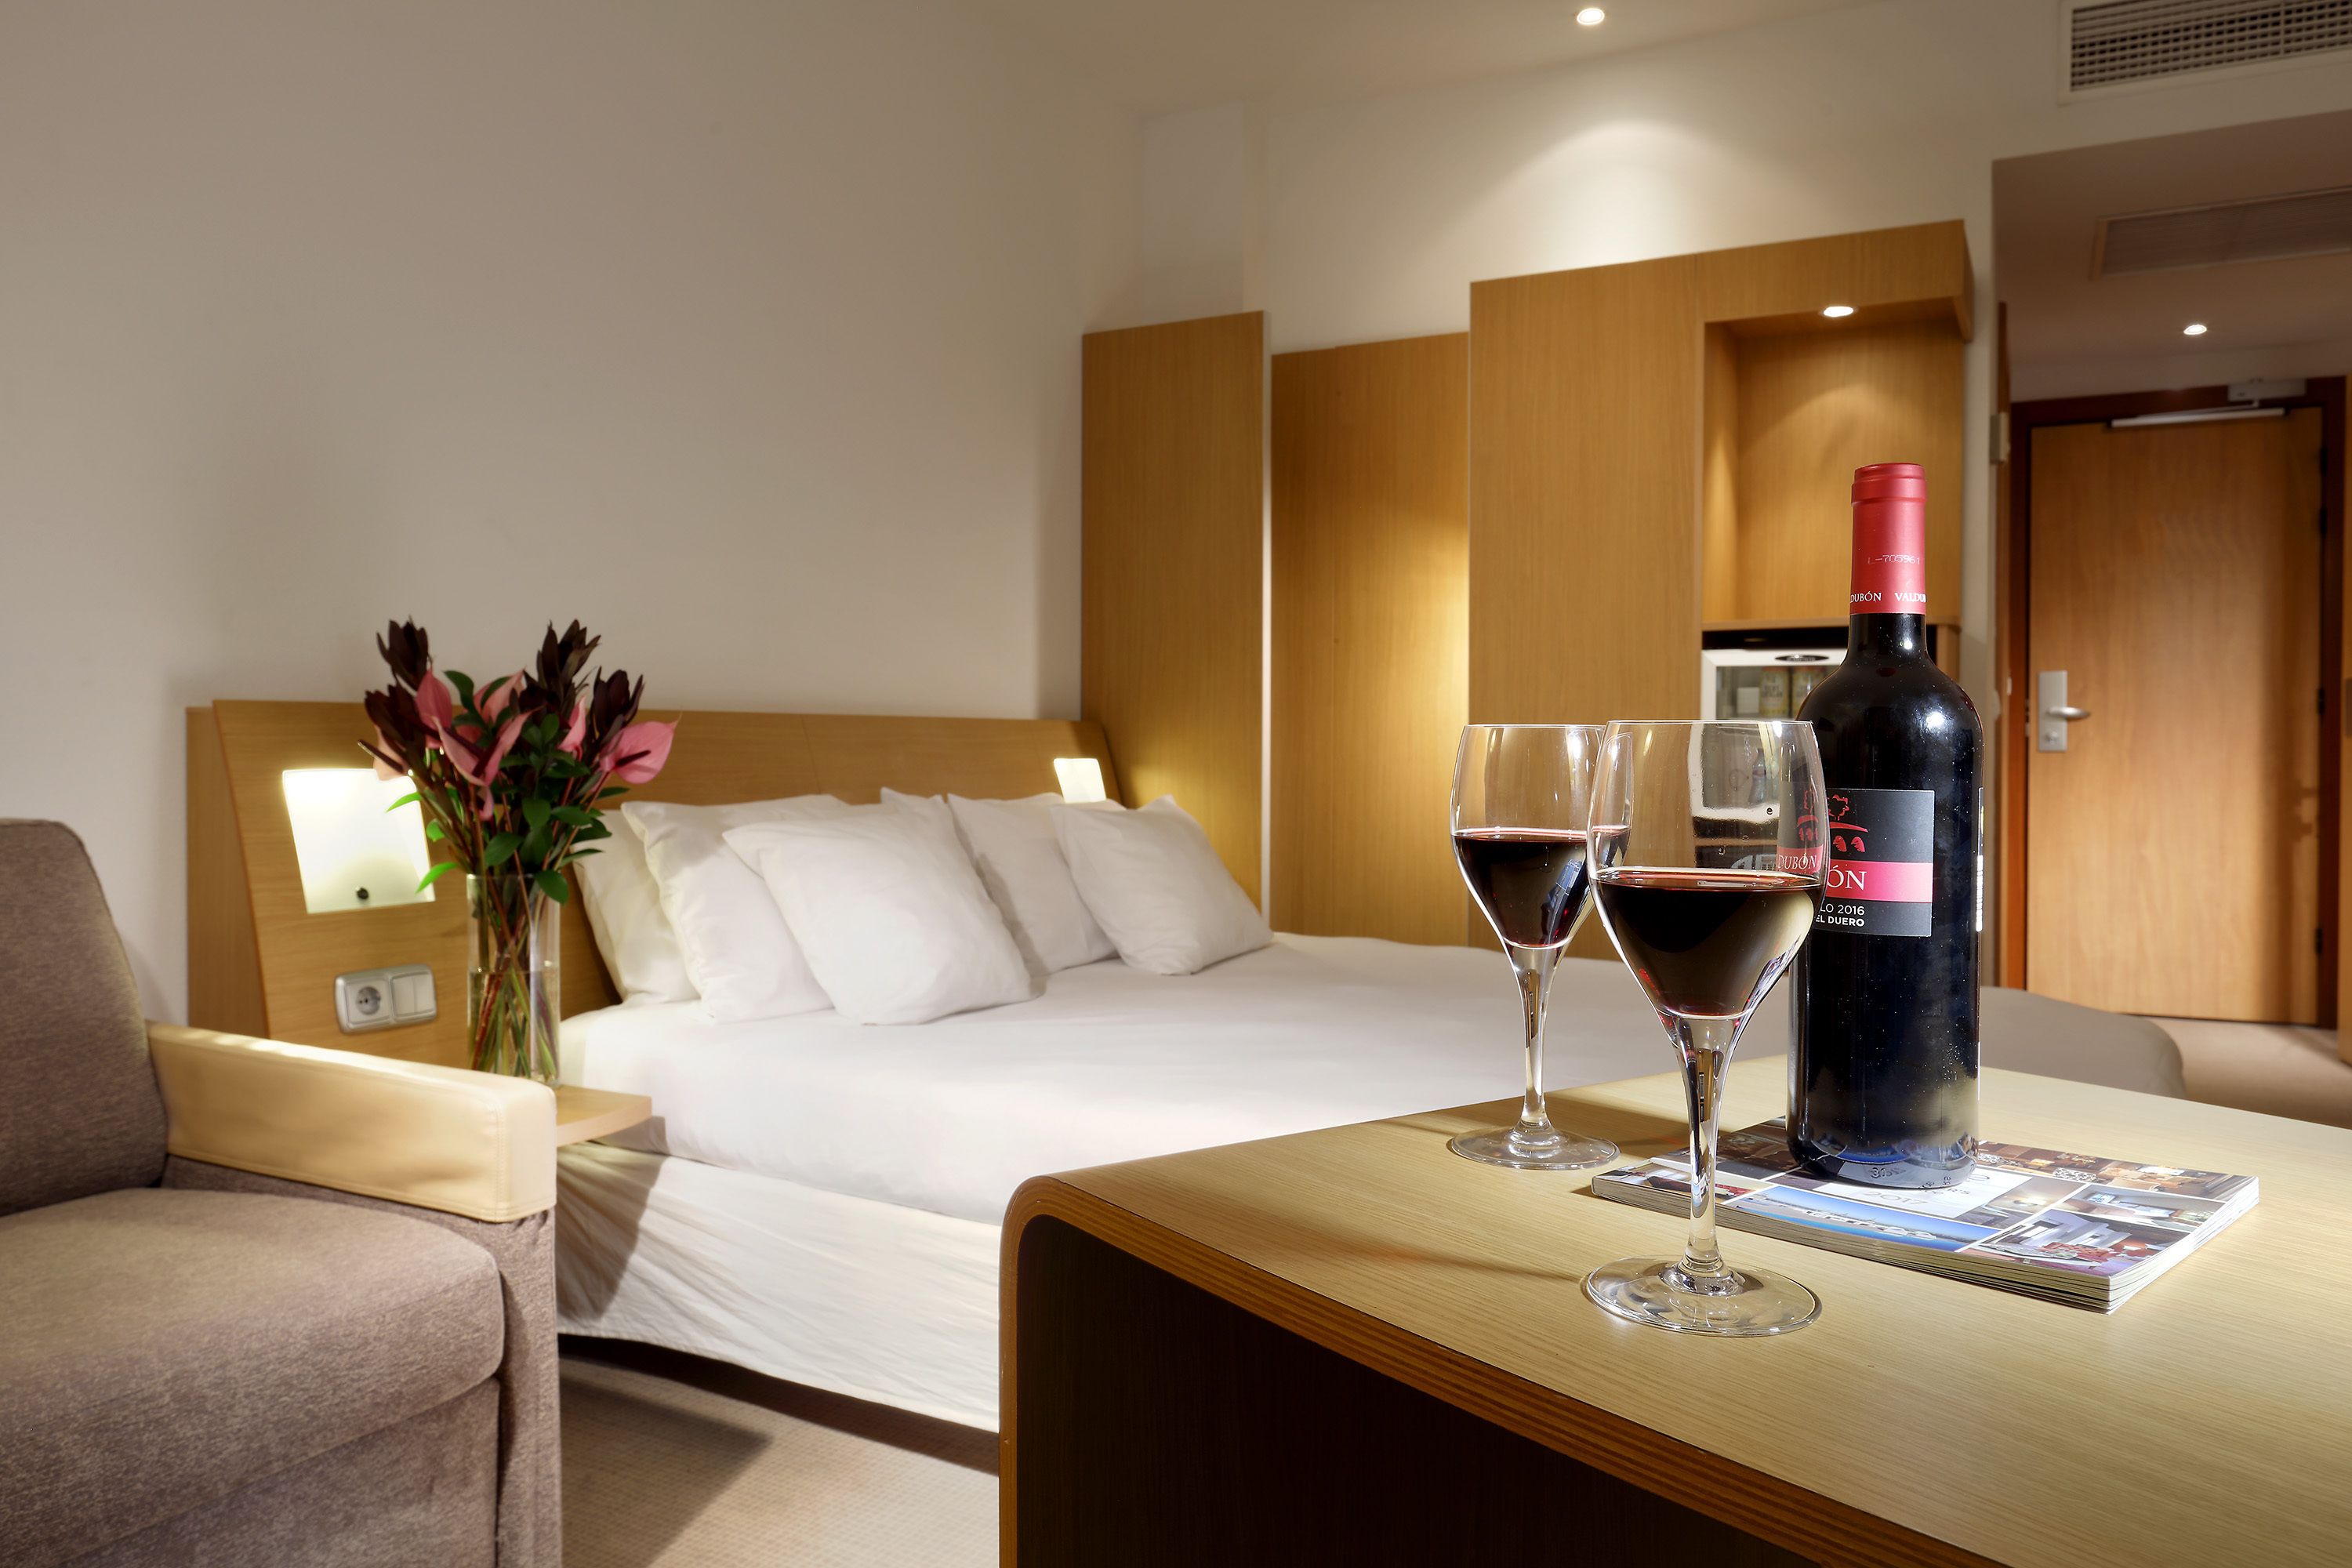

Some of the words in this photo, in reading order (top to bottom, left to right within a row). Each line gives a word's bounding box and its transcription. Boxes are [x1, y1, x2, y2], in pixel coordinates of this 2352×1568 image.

[1828, 864, 1867, 891] ÓN
[1837, 905, 1865, 915] 2016
[1828, 916, 1865, 927] DUERO
[1863, 1191, 1928, 1205] 2017
